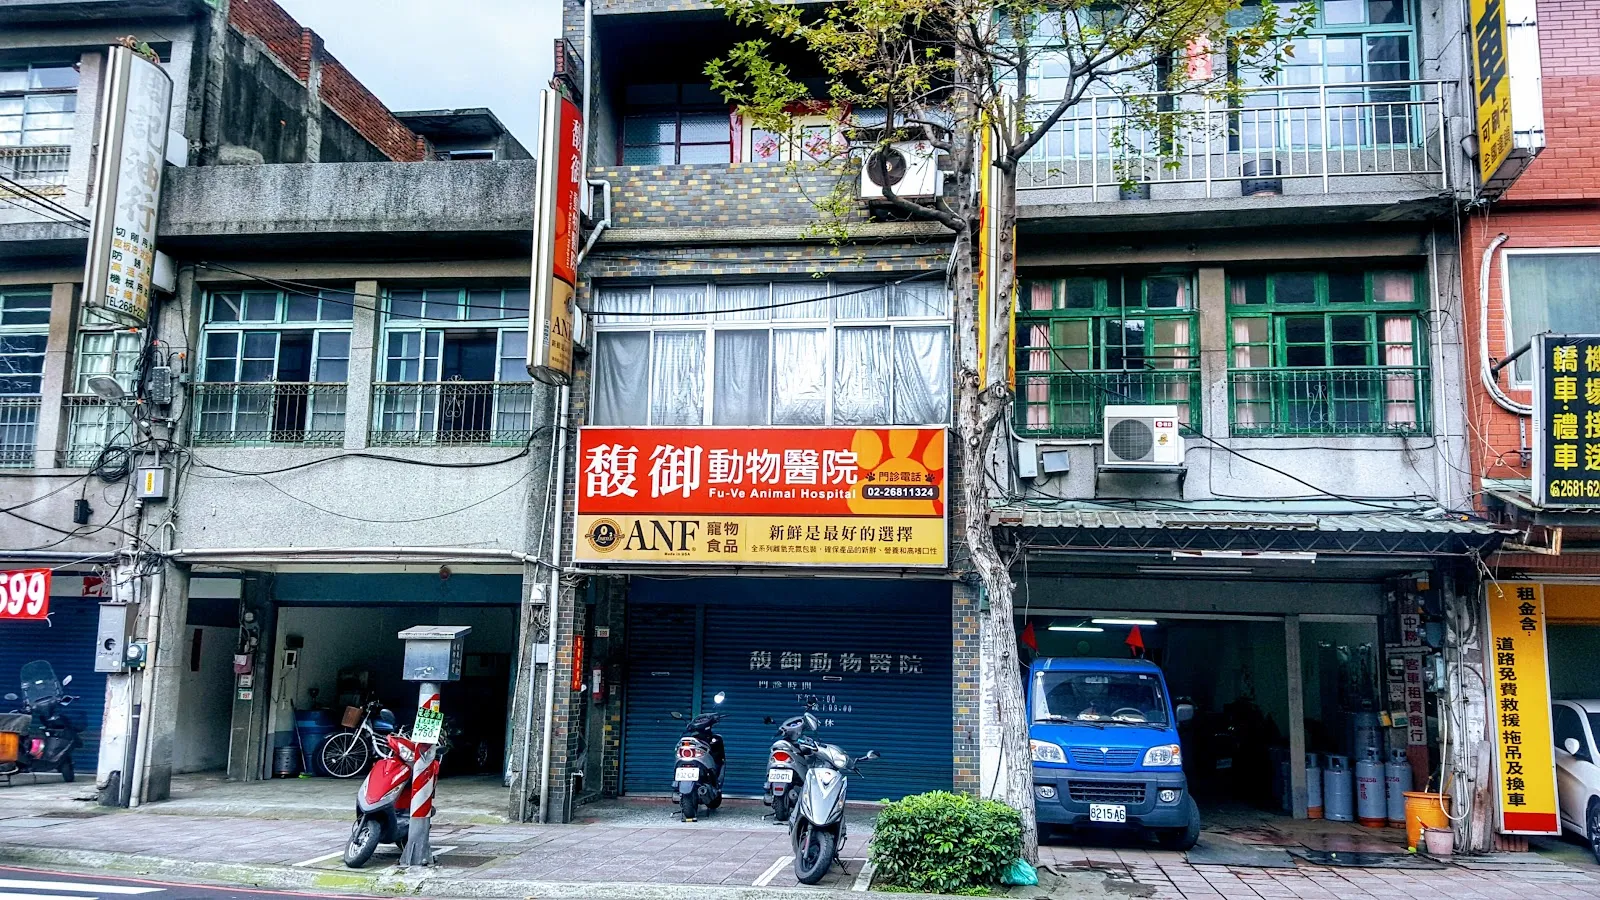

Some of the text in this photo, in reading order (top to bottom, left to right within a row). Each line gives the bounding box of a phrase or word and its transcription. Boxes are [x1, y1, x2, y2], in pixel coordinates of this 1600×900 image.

[552, 316, 572, 342] AN
[584, 443, 858, 498] 馥御動物醫院
[878, 471, 922, 483] 門診電話
[708, 488, 857, 500] Fu-Ve Animal Hospital
[867, 487, 934, 497] 02-26811324
[1560, 480, 1600, 497] 2681-62
[623, 519, 700, 552] ANF
[706, 521, 739, 536] 寵物
[769, 524, 913, 543] 新鮮是最好的選擇
[706, 538, 738, 554] 食品
[749, 651, 924, 674] 馥御動物醫院
[1405, 658, 1425, 742] 客車租賃商行
[1495, 636, 1527, 807] 道路免費救援拖吊及換車
